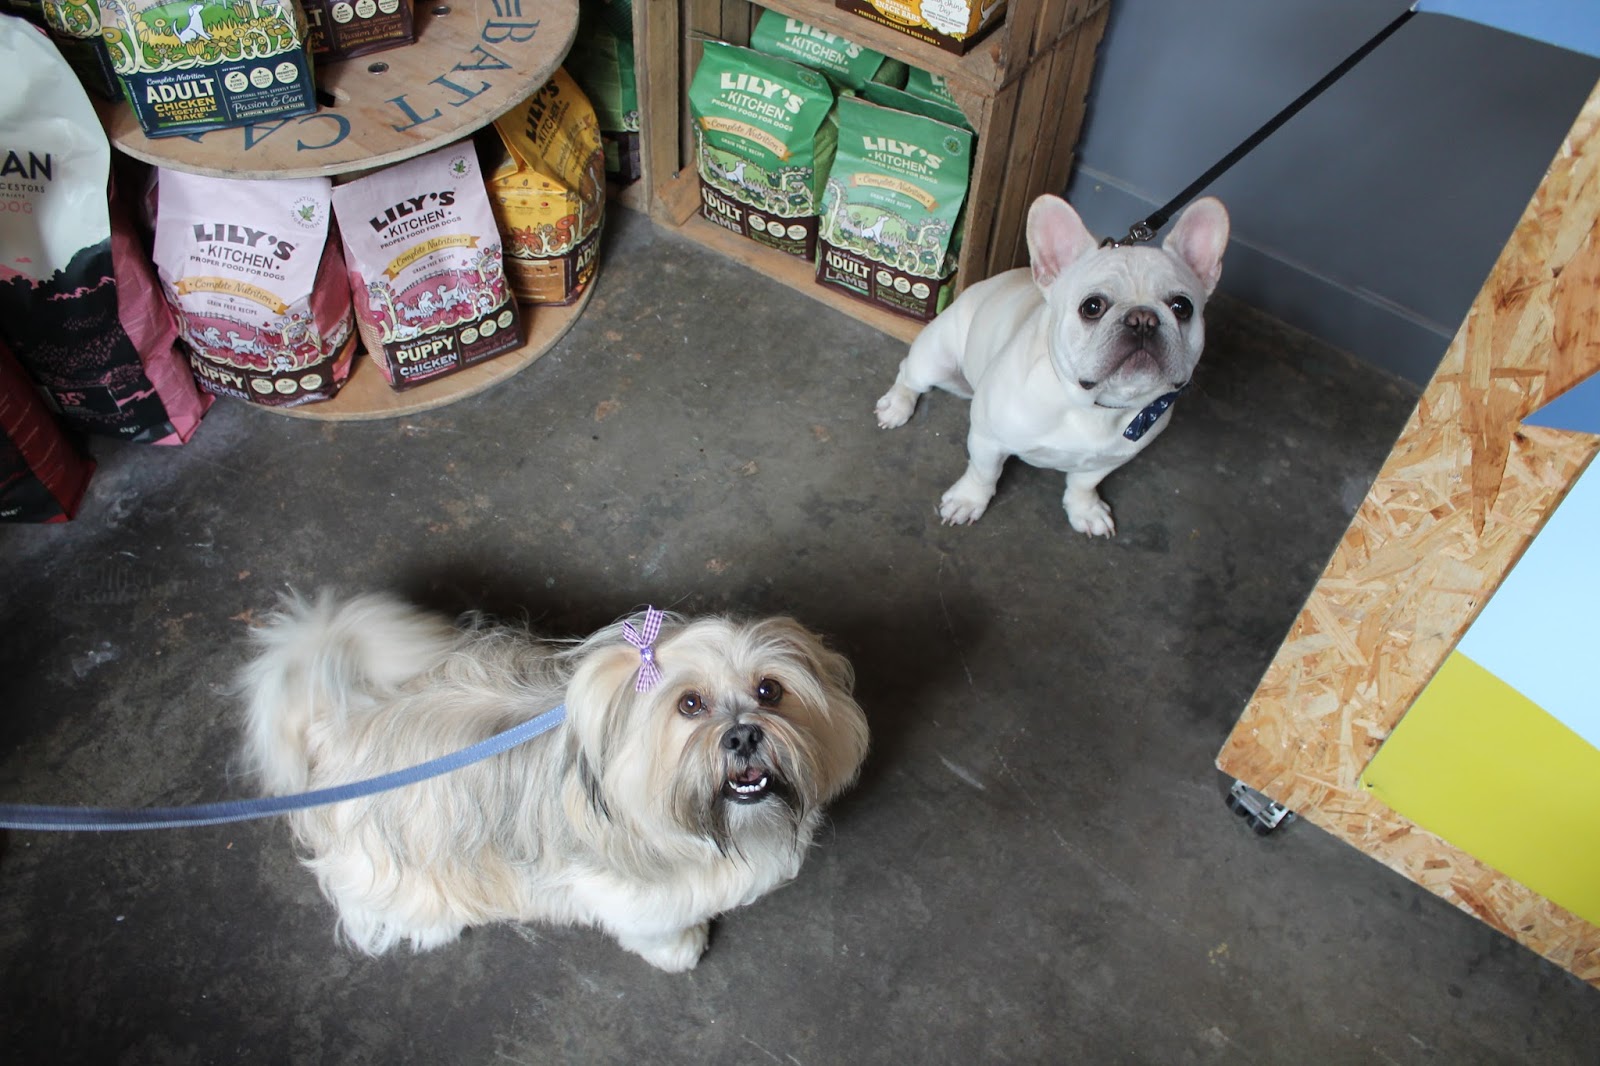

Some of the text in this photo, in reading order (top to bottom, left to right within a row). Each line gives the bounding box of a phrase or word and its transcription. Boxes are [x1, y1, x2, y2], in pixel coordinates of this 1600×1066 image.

[902, 8, 920, 22] BARS
[776, 42, 802, 55] PROPER
[802, 52, 822, 64] FOOD
[792, 36, 846, 65] KITCHEN
[146, 73, 206, 86] Complete Nutrition
[146, 78, 214, 104] ADULT
[721, 72, 804, 114] LILY'S
[154, 97, 216, 112] CHICKEN
[165, 105, 218, 116] VEGETABLE
[232, 94, 304, 112] Passion & Care
[525, 80, 560, 144] LILY'S
[712, 98, 793, 132] PROPER FOOD FOR DOGS
[727, 91, 786, 120] KITCHEN
[175, 112, 205, 122] BAKE
[710, 118, 778, 150] Complete Nutrition
[862, 136, 942, 170] LILY'S
[874, 152, 927, 174] KITCHEN
[862, 157, 938, 184] PROPER FOOD FOR DOGS
[369, 190, 455, 232] LILY'S
[702, 188, 742, 222] ADULT
[388, 209, 446, 238] KITCHEN
[704, 204, 742, 234] LAMB
[193, 224, 295, 261] LILY'S
[380, 216, 462, 250] PROPER FOOD FOR DOGS
[208, 244, 274, 270] KITCHEN
[396, 236, 463, 268] Complete Nutrition
[427, 260, 438, 268] FREE
[438, 254, 454, 264] RECIPE
[826, 250, 870, 279] ADULT
[190, 256, 285, 281] PROPER FOOD FOR DOGS
[826, 268, 868, 290] LAMB
[194, 278, 272, 305] Complete Nutrition
[207, 300, 258, 316] GRAIN FREE RECIPE
[396, 336, 454, 364] PUPPY
[191, 356, 244, 389] PUPPY
[400, 352, 458, 376] CHICKEN
